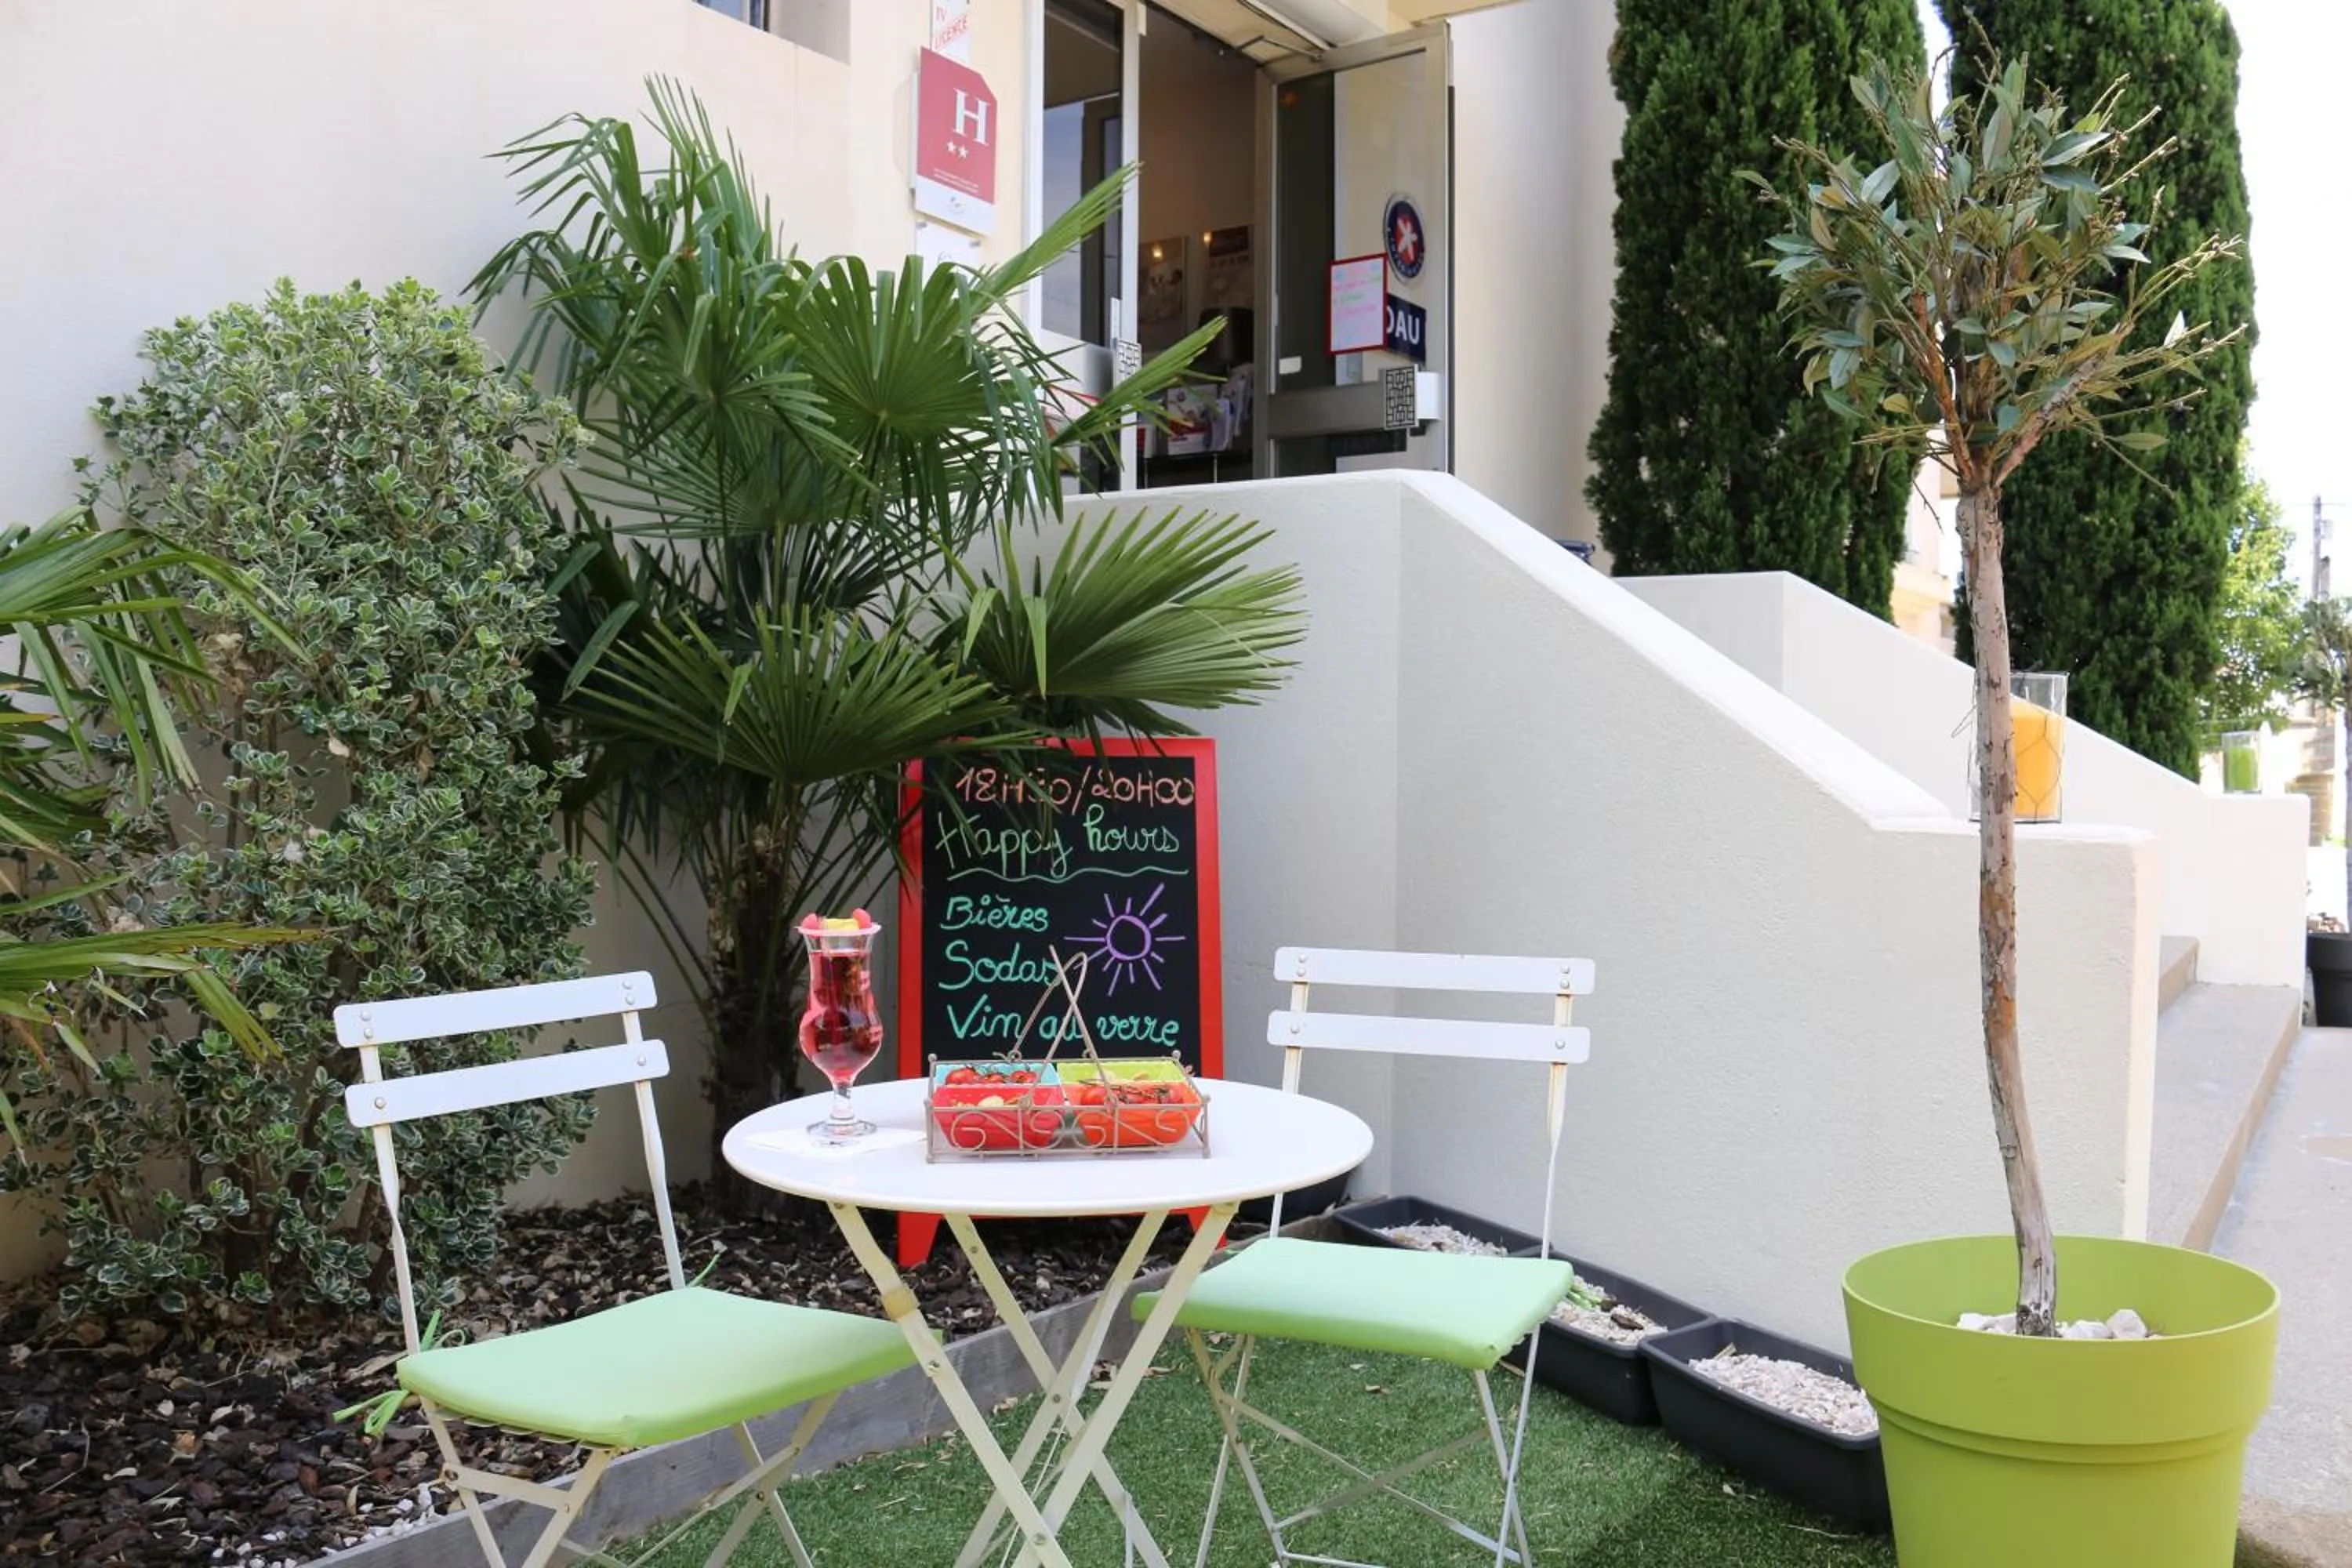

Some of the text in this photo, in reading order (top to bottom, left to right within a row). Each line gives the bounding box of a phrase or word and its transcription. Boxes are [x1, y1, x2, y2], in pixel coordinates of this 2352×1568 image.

[953, 87, 991, 147] H
[935, 804, 1179, 878] Happy hours
[939, 893, 1049, 932] Bières
[938, 939, 1062, 990] Sodas
[946, 993, 1179, 1047] Vin au verre
